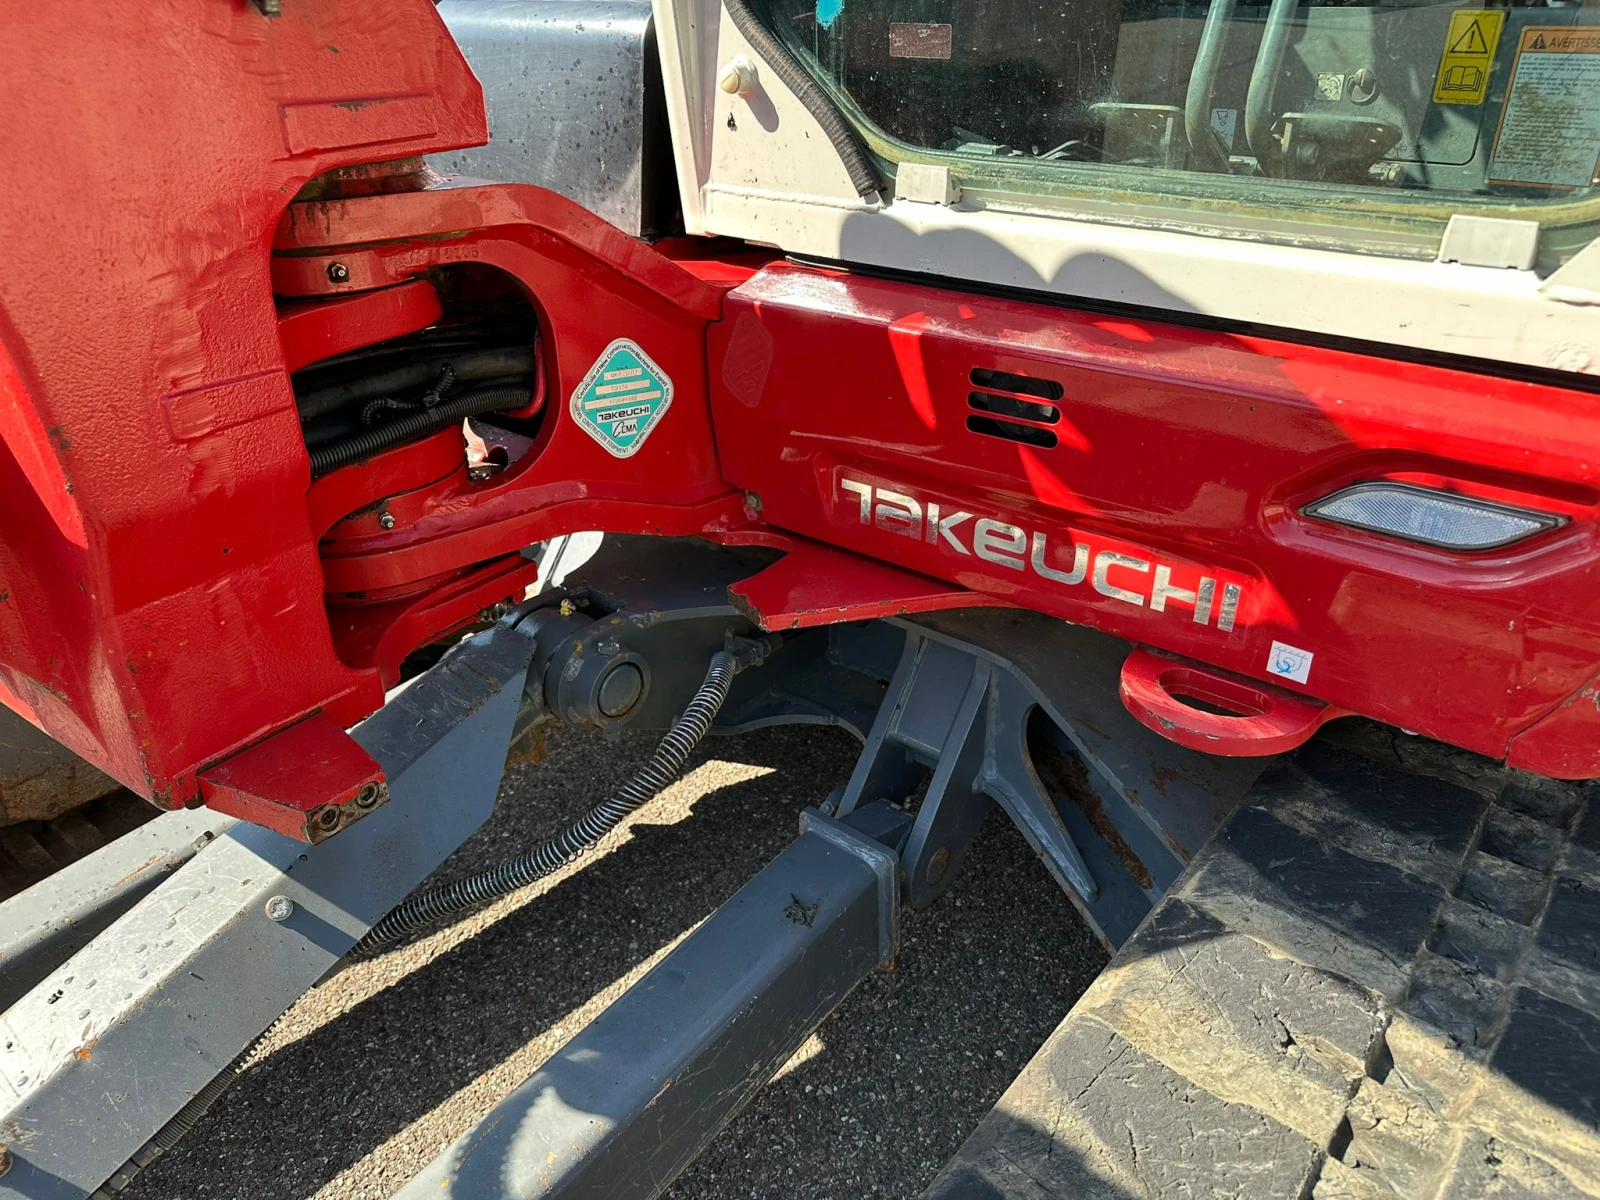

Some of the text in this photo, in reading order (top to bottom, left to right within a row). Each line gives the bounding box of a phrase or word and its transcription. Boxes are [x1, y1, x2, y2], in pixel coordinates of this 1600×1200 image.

[576, 375, 597, 400] Certificate
[595, 368, 601, 376] of
[598, 359, 608, 371] New
[606, 344, 636, 359] Construction
[635, 352, 653, 369] Machine
[649, 365, 657, 375] for
[654, 371, 668, 387] Export
[581, 417, 607, 442] CONSTRUCTION
